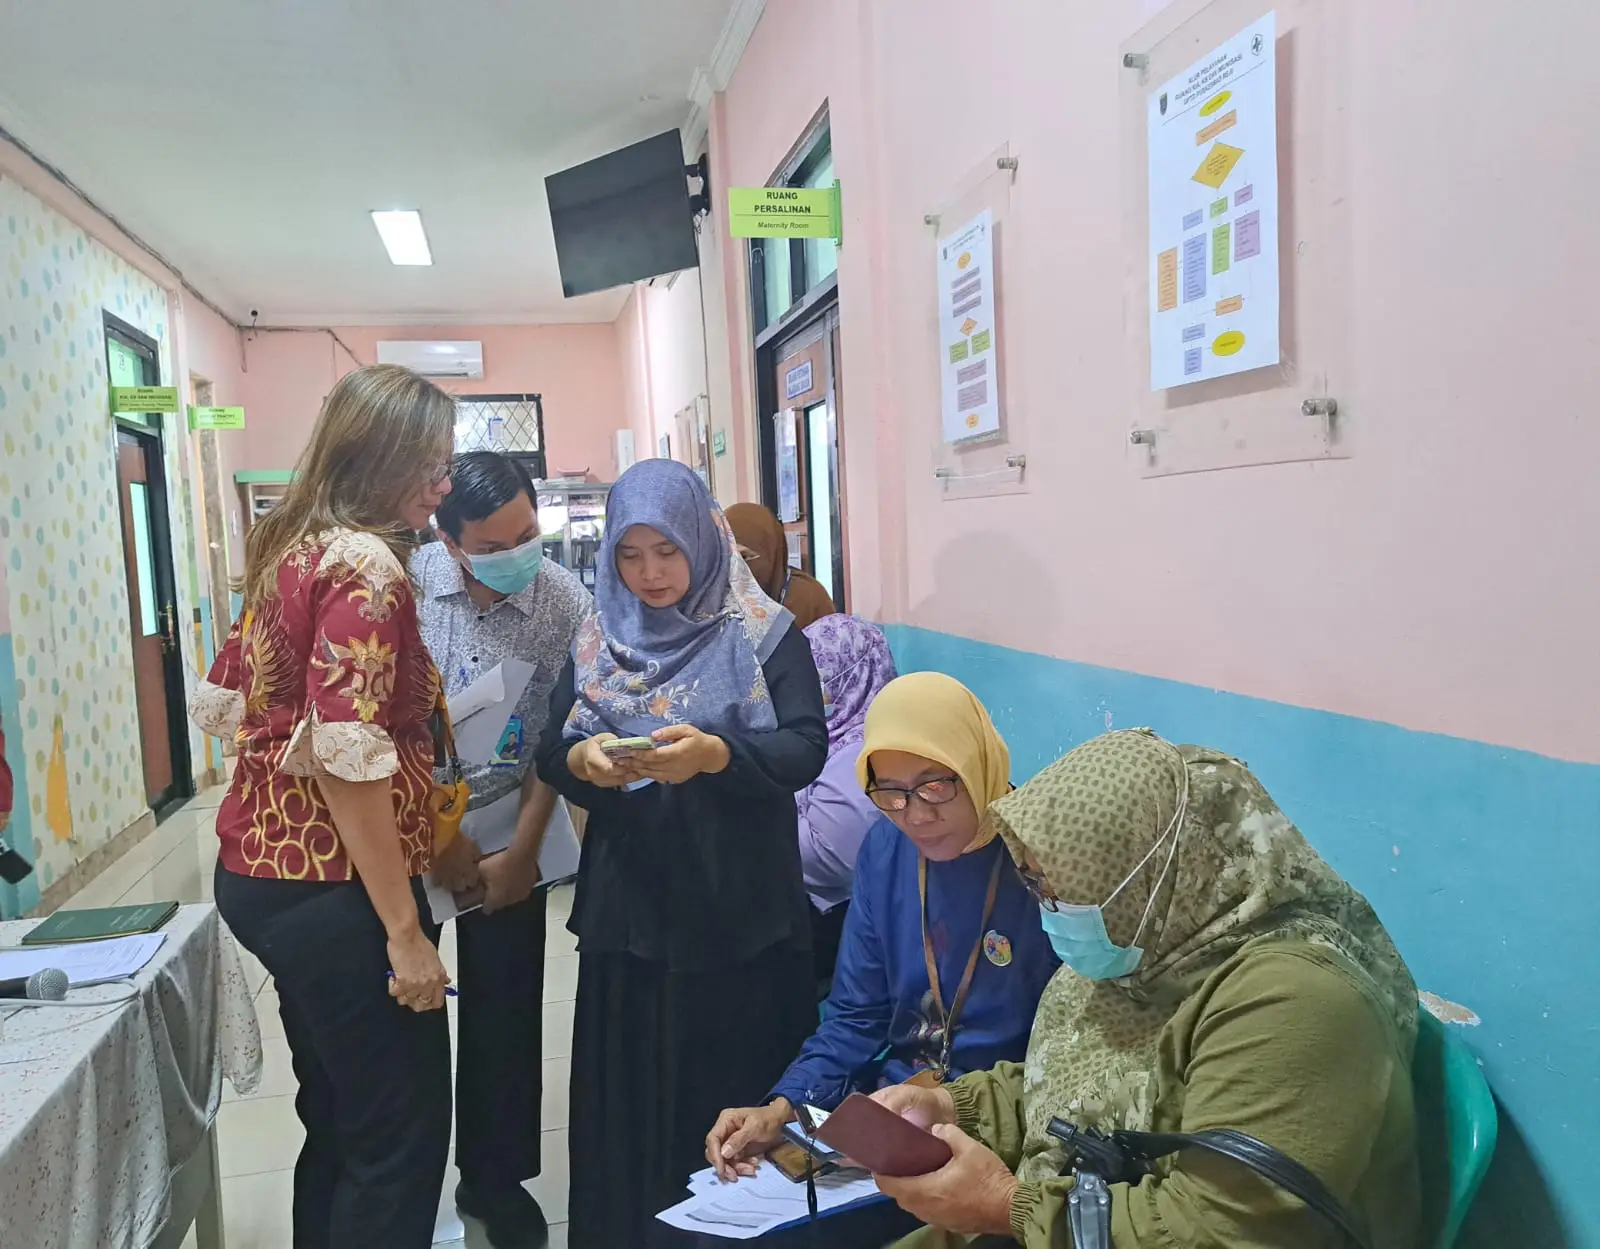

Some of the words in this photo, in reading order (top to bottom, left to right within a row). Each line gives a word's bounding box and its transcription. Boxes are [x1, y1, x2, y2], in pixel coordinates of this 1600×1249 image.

[766, 191, 798, 200] RUANG
[754, 204, 811, 213] PERSALINAN
[757, 221, 788, 229] Maternity
[789, 221, 809, 229] Room
